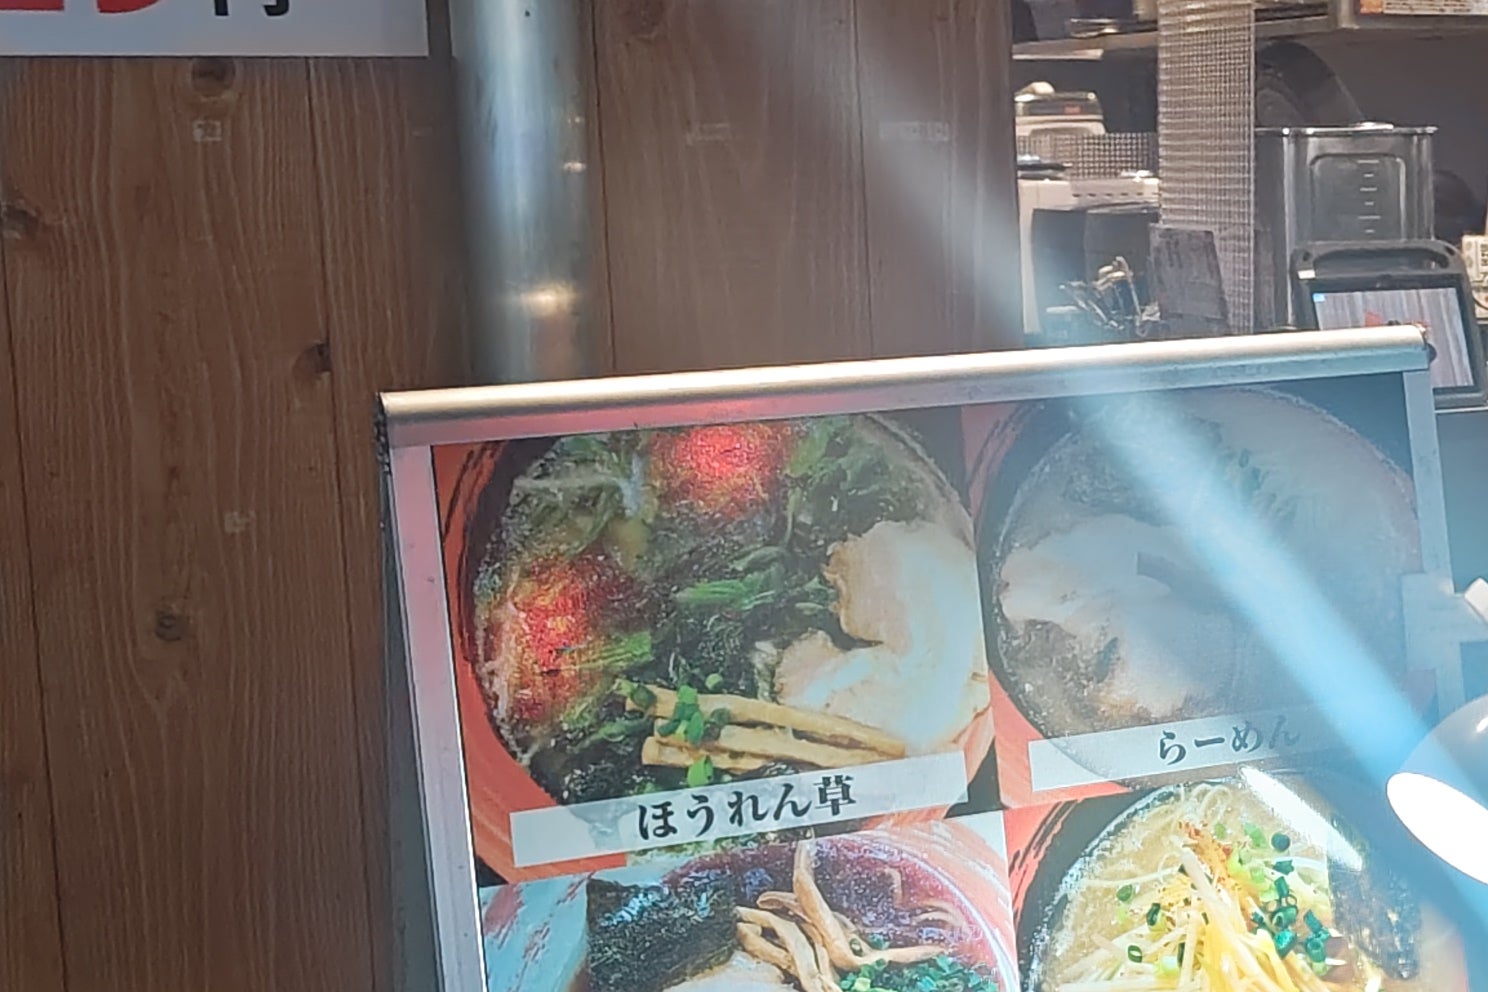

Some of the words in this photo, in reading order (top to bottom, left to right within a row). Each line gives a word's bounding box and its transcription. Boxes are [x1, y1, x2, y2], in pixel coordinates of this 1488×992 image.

[1159, 714, 1300, 766] らーめん
[637, 774, 857, 840] ほうれん草
